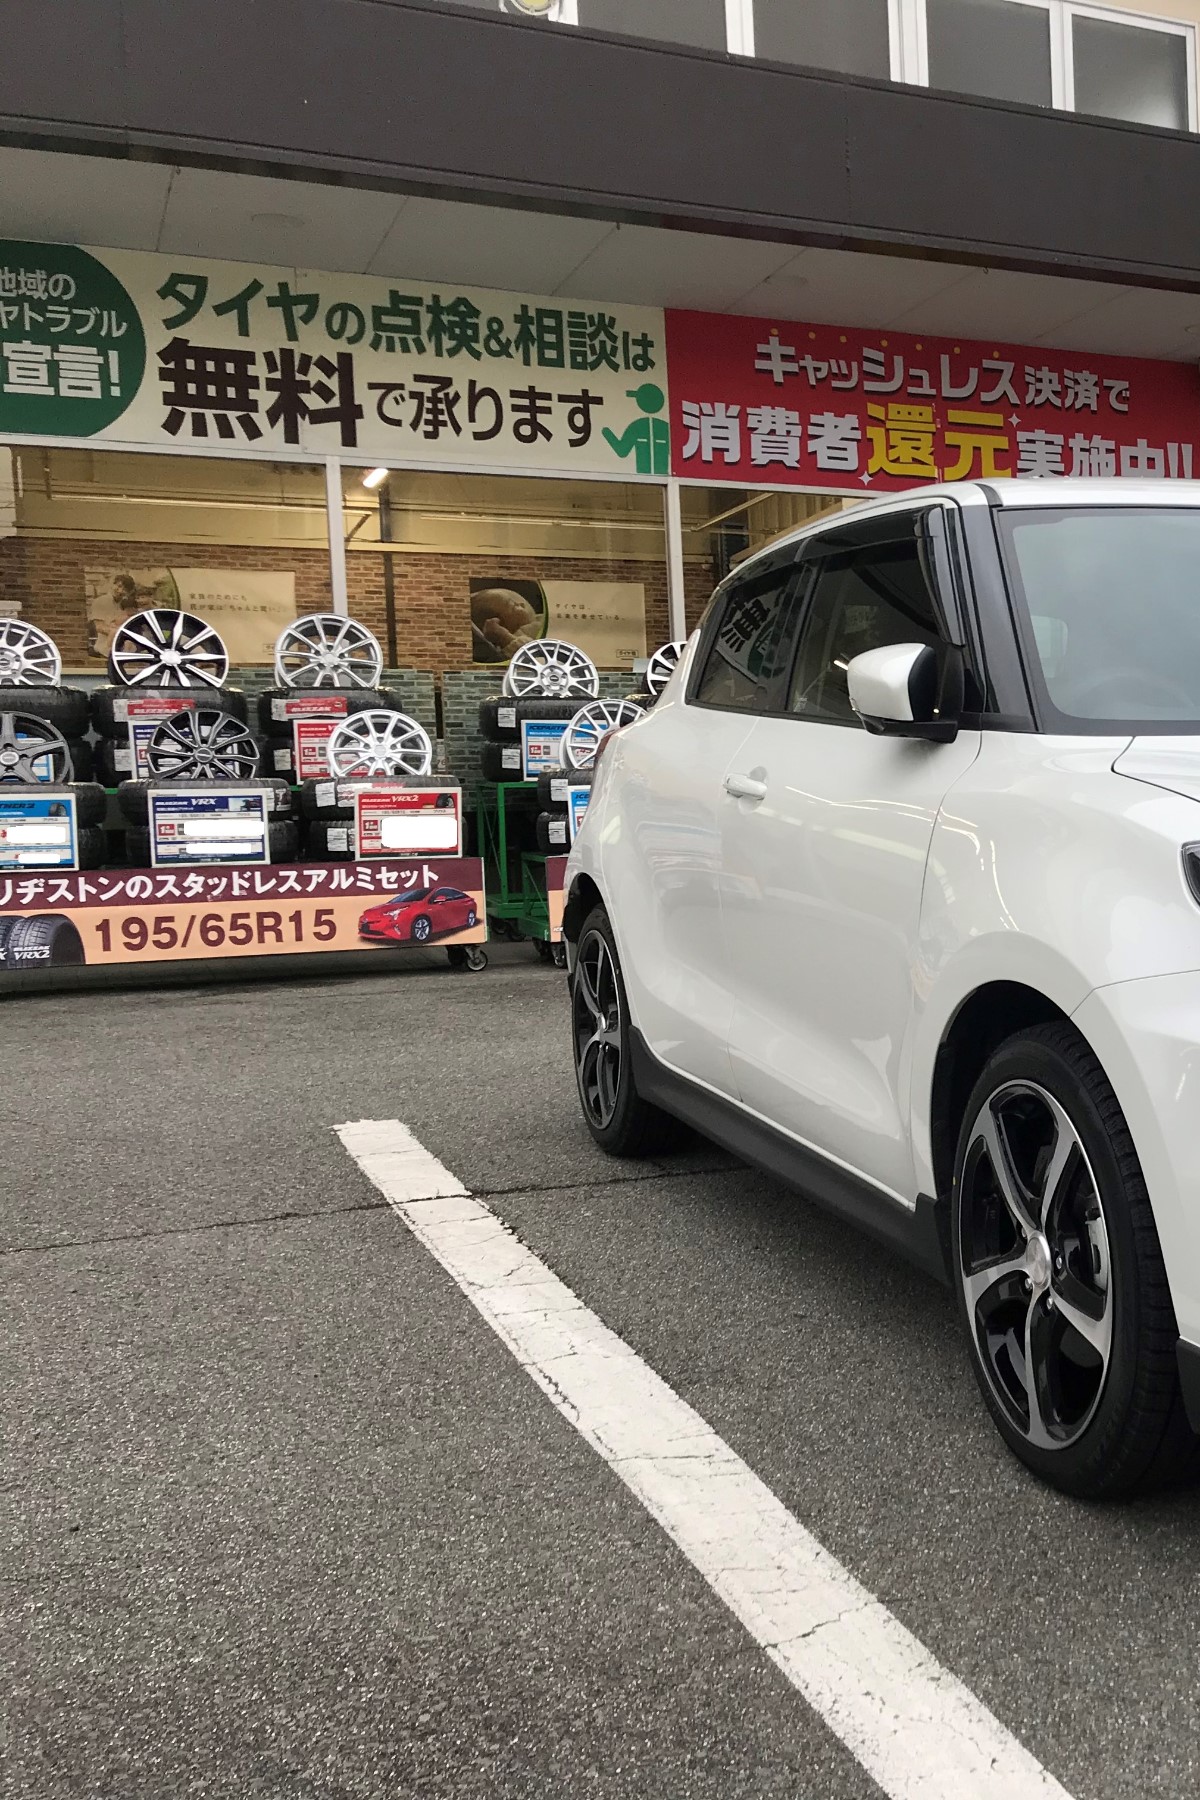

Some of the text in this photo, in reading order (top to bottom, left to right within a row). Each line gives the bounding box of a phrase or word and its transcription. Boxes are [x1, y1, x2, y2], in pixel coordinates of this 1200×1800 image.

[0, 302, 127, 338] ヤトラブル
[156, 272, 656, 374] タイヤの点検&相談は
[157, 337, 604, 448] 無料で承ります
[754, 336, 1130, 412] キャッシュレス決済で
[682, 400, 1193, 480] 消費者還元実施中!!
[191, 798, 217, 806] VRX
[14, 949, 50, 960] VRX2
[95, 908, 337, 952] 195/65R15
